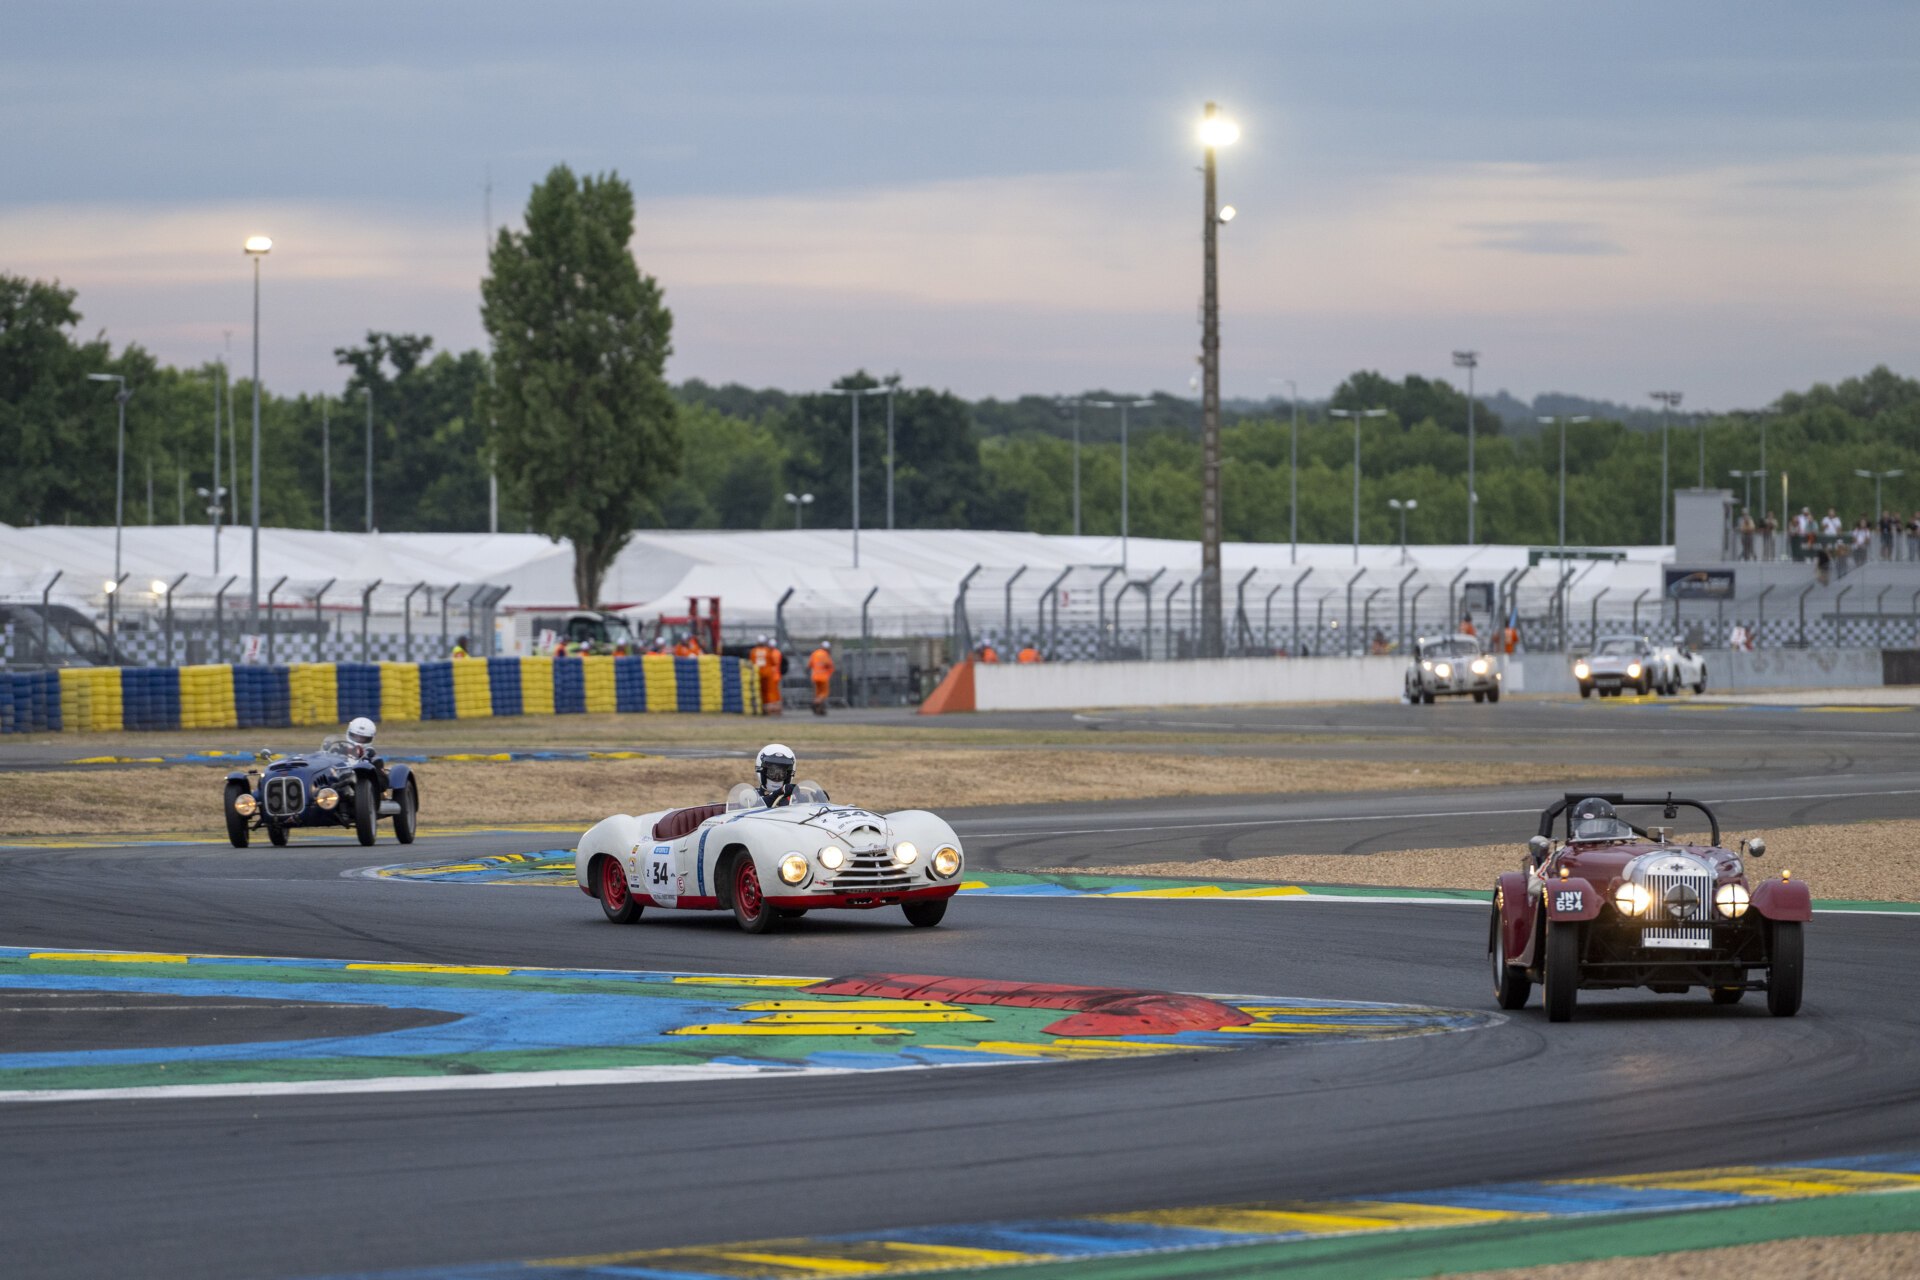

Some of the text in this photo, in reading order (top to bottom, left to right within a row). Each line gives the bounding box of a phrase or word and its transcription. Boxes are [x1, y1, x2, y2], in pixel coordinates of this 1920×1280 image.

[269, 781, 302, 812] 59
[653, 862, 668, 885] 34
[1556, 891, 1582, 901] JNV
[1556, 900, 1583, 911] 654
